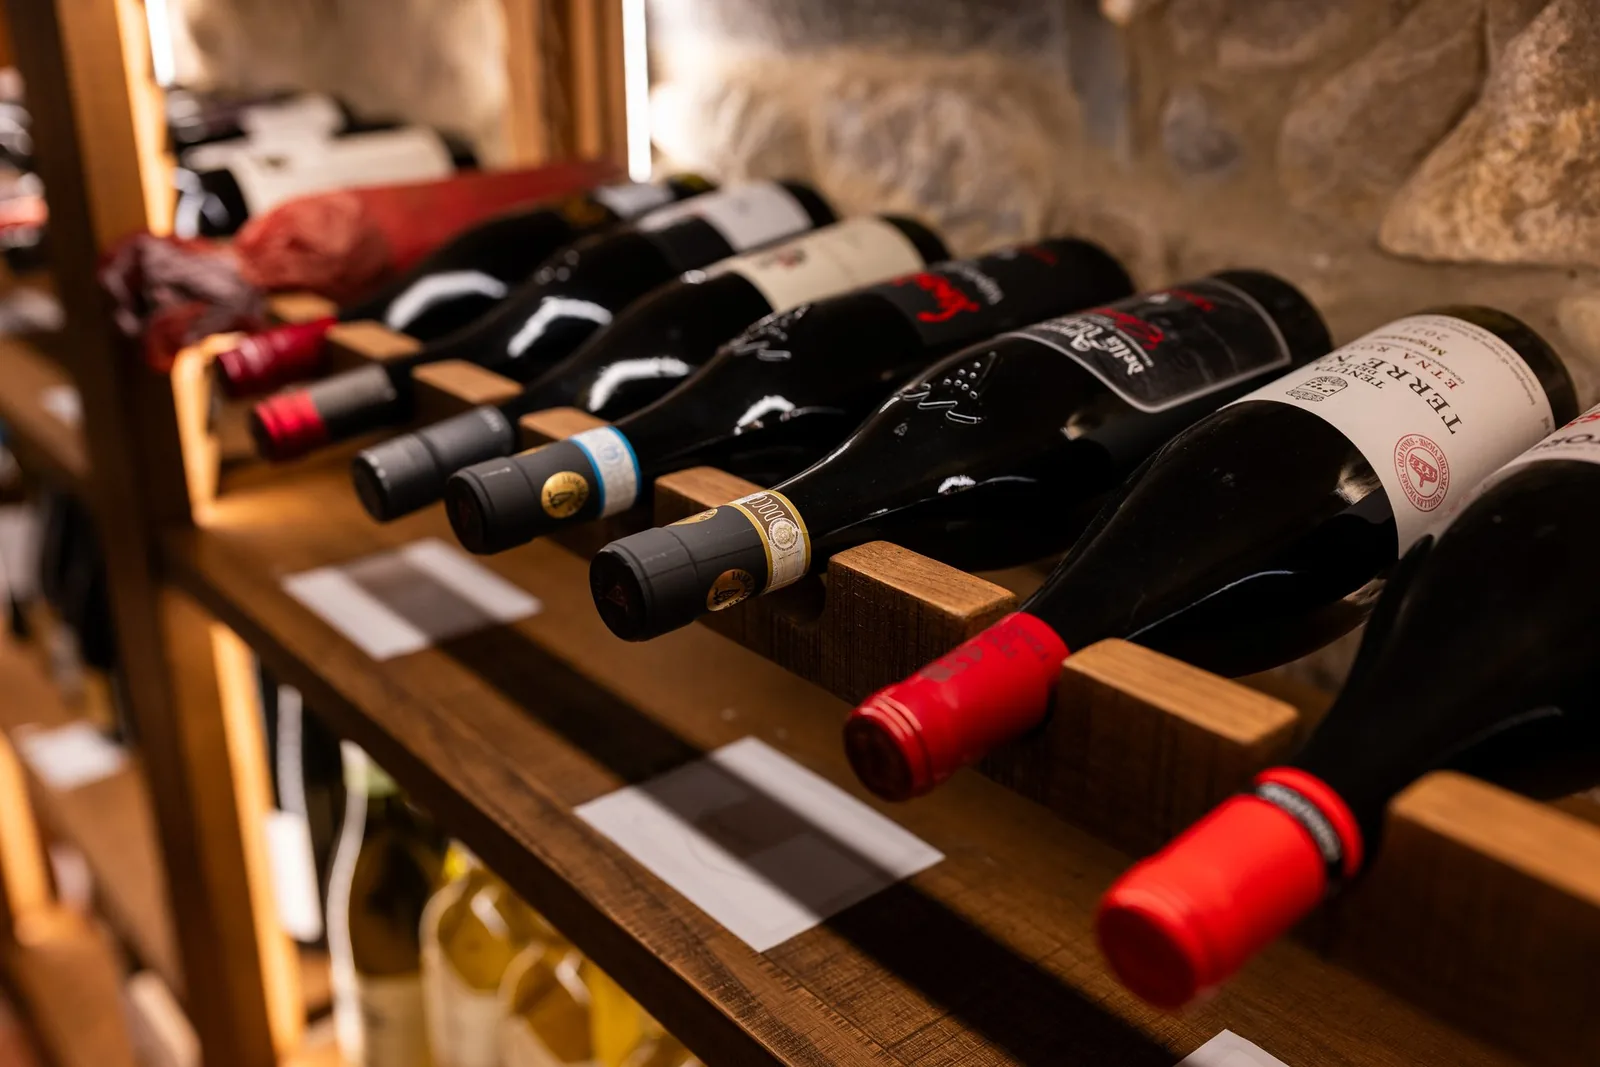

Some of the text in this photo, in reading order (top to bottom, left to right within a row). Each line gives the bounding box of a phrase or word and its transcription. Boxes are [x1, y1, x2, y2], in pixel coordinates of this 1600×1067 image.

[1314, 366, 1386, 389] TENUTA
[1404, 353, 1459, 389] ETNA
[1368, 357, 1462, 434] TERRE
[1397, 438, 1416, 468] OLD VINES
[1419, 438, 1438, 457] VIGNE
[1400, 473, 1417, 502] VIGNES
